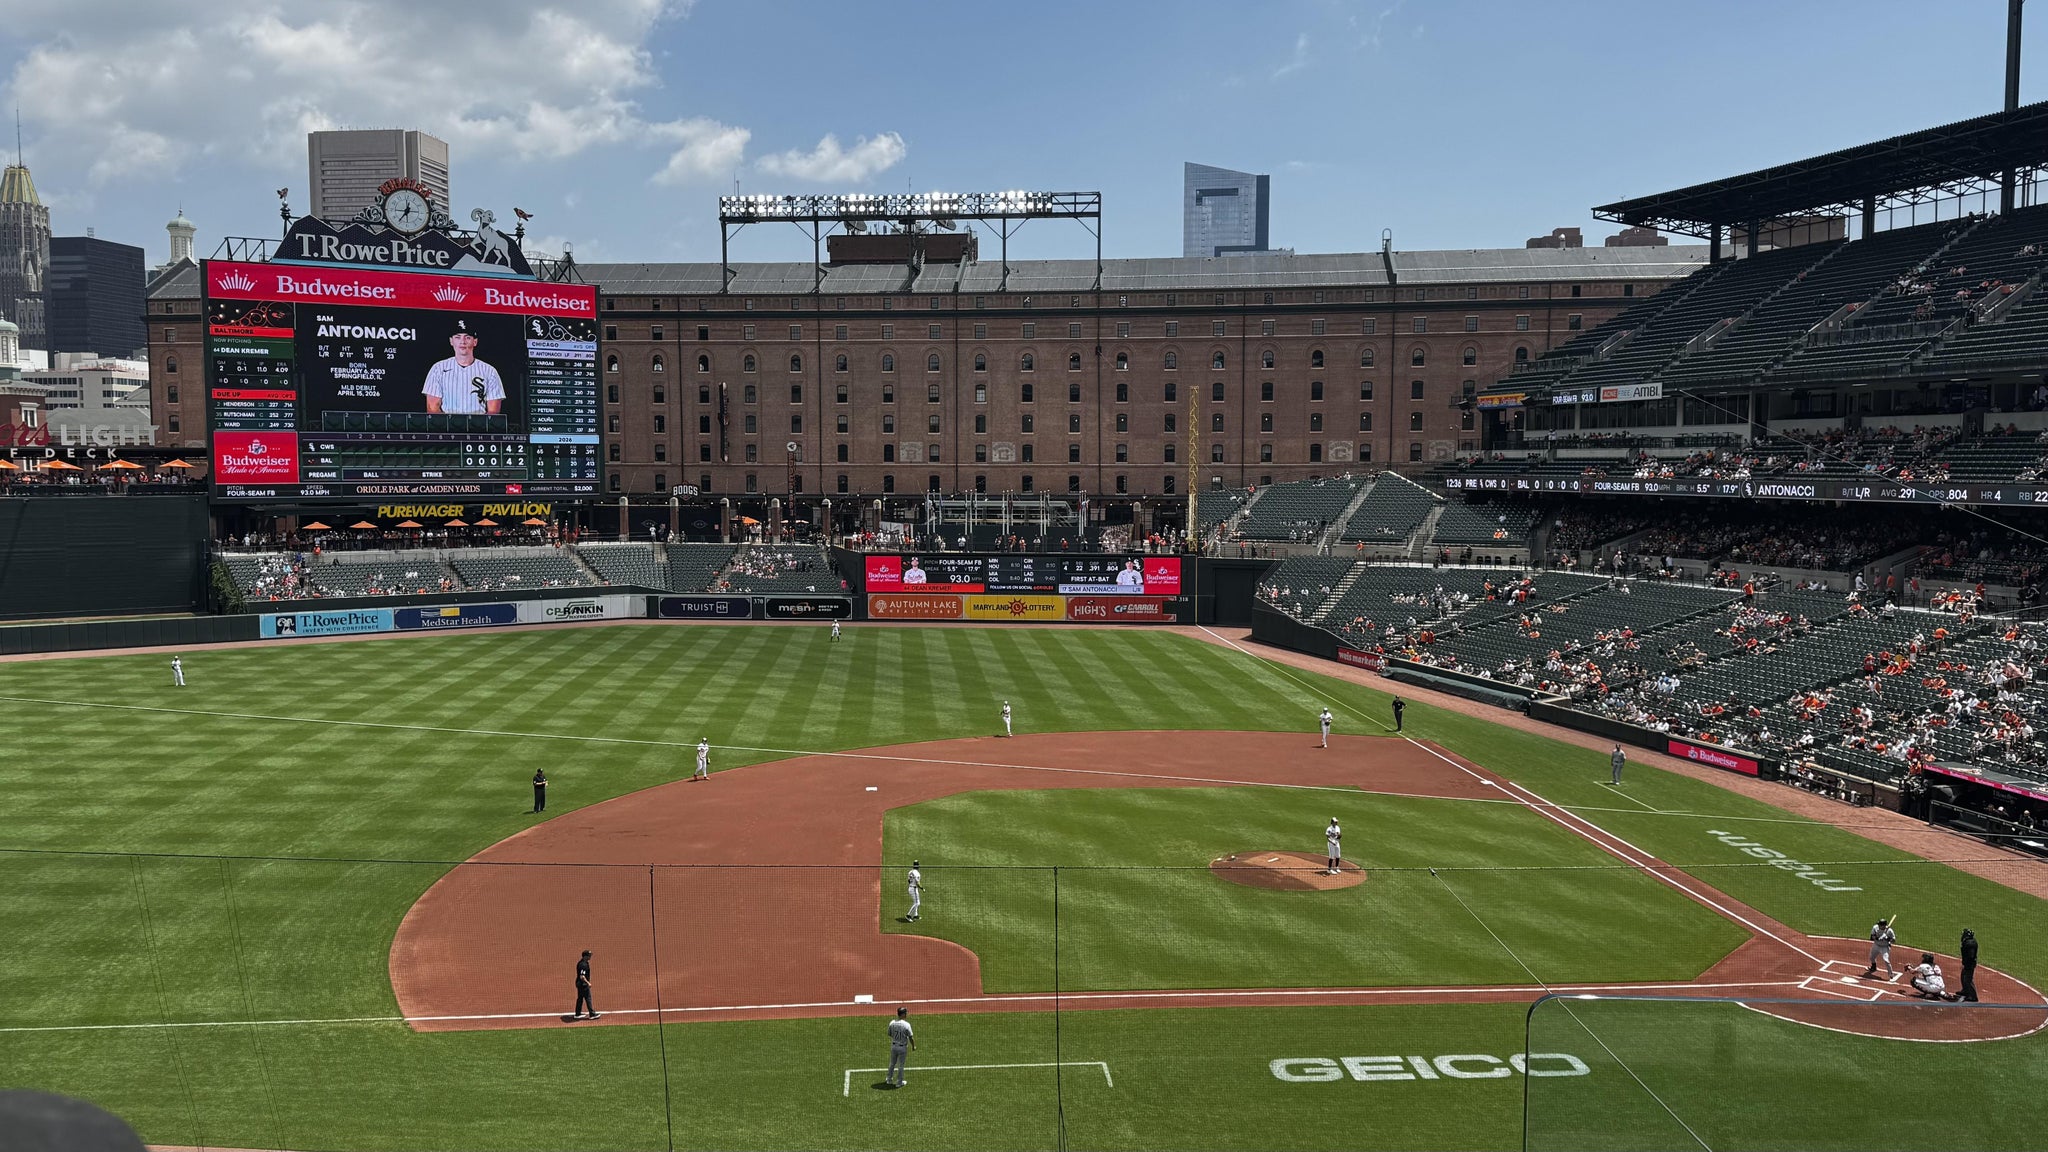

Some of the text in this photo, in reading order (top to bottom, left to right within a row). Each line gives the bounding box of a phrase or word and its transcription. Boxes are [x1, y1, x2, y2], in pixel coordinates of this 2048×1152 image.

[277, 276, 394, 299] Budweiser
[485, 288, 589, 311] Budweiser
[317, 325, 416, 340] ANTONACCI
[1633, 386, 1658, 397] AMBI
[61, 424, 160, 446] LIGHT
[223, 455, 291, 466] Budweiser
[221, 466, 248, 474] Made
[356, 485, 481, 494] ORIOLE PARK CAMDEN YARDS
[1446, 480, 1462, 488] 12:36
[1485, 480, 1497, 488] CWS
[1501, 480, 1506, 488] 0
[1518, 480, 1529, 488] BAL
[1535, 480, 1540, 488] 0
[1549, 480, 1554, 489] 0
[1561, 481, 1565, 489] 0
[1573, 481, 1578, 490] 0
[1594, 482, 1630, 490] FOUR-SEAM
[1631, 483, 1639, 491] FB
[1645, 483, 1658, 492] 93.0
[1758, 484, 1814, 496] ANTONACCI
[1843, 488, 1853, 497] B/T
[1855, 488, 1870, 499] L/R
[1881, 489, 1896, 497] AVG
[1898, 489, 1915, 498] .291
[1929, 490, 1944, 499] OPS
[1946, 490, 1968, 500] .804
[1981, 491, 1992, 499] HR
[1994, 491, 2001, 500] 4
[2019, 492, 2033, 500] RBI
[2035, 492, 2048, 501] 22
[378, 503, 551, 518] PUREWAGER PAVILION
[950, 575, 970, 583] 93.0
[546, 605, 603, 616] CP RANKIN
[1075, 606, 1106, 617] HIGH'S
[421, 616, 492, 627] MedStar Health
[1339, 652, 1377, 667] weis markets
[1700, 750, 1738, 768] Budweiser
[1269, 1053, 1591, 1082] GEICO
